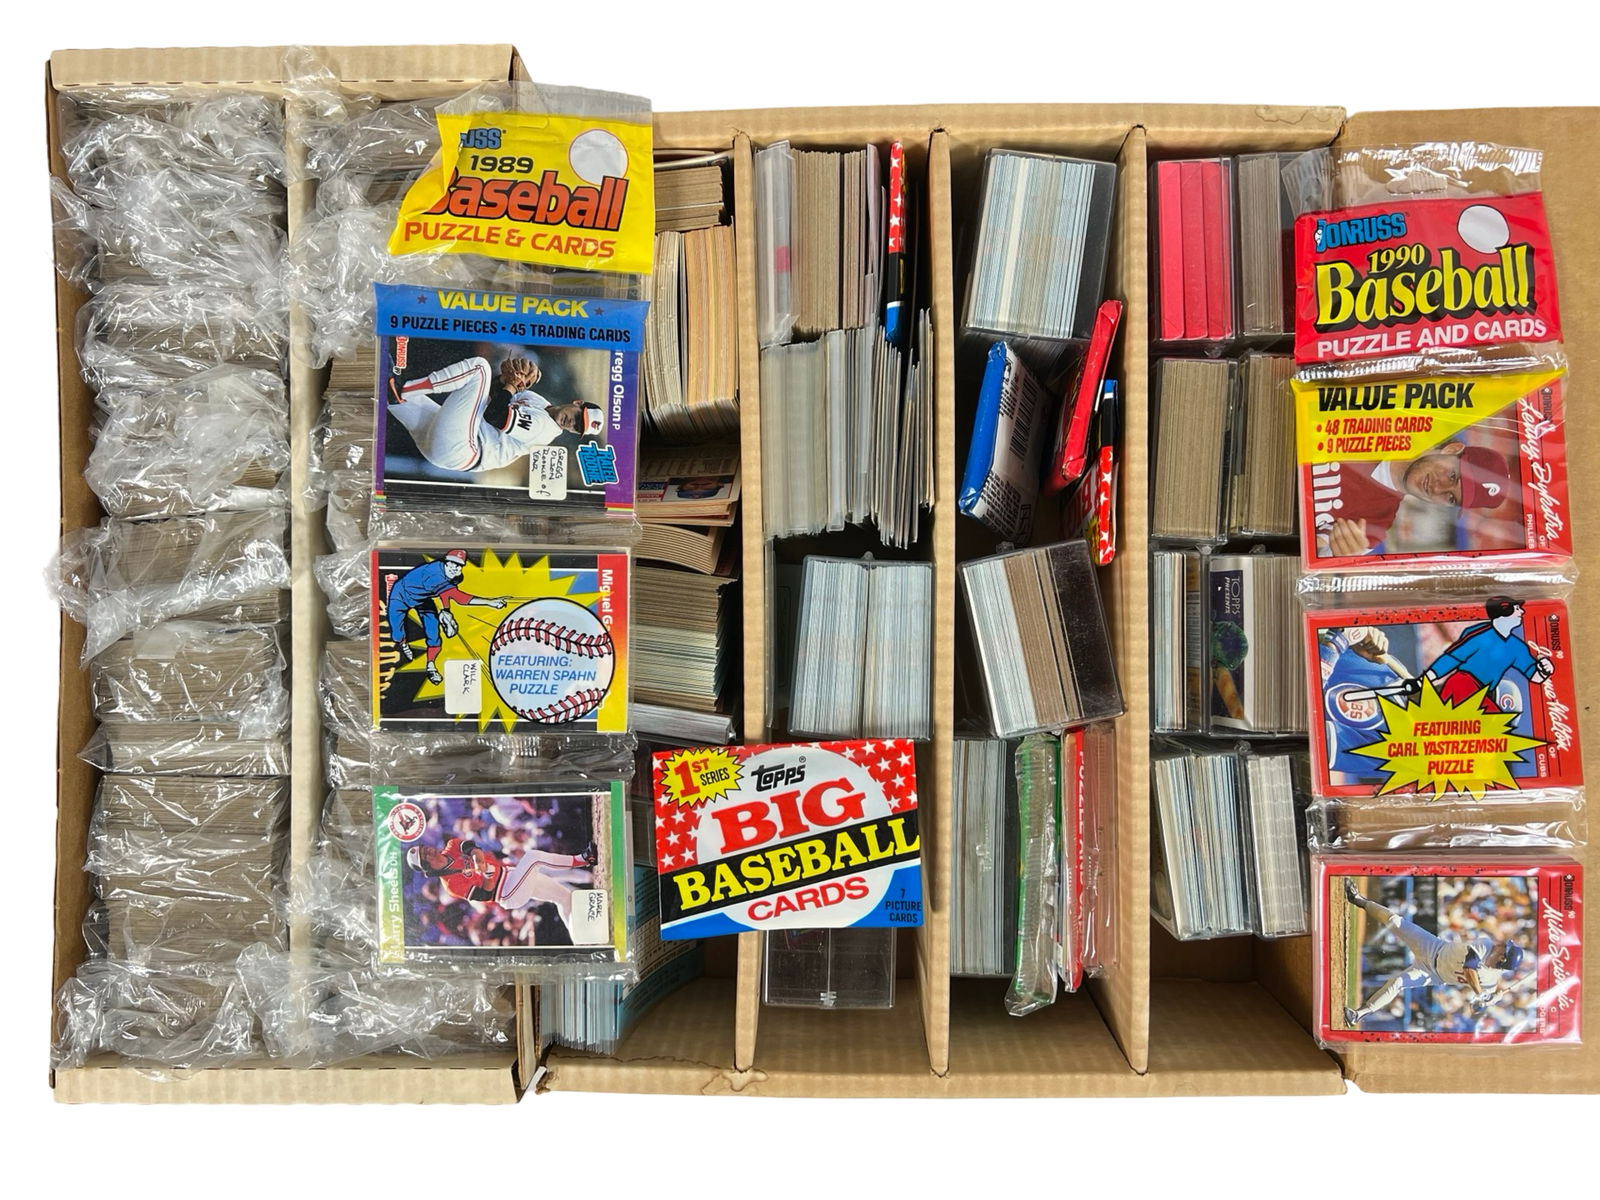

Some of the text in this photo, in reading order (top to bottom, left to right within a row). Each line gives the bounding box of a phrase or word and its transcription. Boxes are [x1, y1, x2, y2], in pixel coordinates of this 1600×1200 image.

[470, 154, 533, 174] 1989
[404, 221, 617, 258] PUZZLE & CARDS
[1369, 243, 1425, 274] 1990
[1315, 244, 1534, 330] Baseball
[437, 290, 589, 318] VALUE PACK
[390, 315, 631, 343] 9 PUZZLE PIECES 45 TRADING CARDS
[1317, 318, 1547, 358] PUZZLE AND CARDS
[612, 351, 624, 431] regg Olson P
[1318, 382, 1476, 412] VALUE PACK
[1325, 416, 1434, 436] 48 TRADING CARDS
[1327, 436, 1411, 453] 9 PUZZLE PIECES
[549, 450, 557, 480] OLSON
[556, 448, 566, 479] GREGG
[1518, 398, 1563, 542] Lenny Dykstra
[1526, 513, 1535, 549] PHILLIES
[1539, 535, 1546, 547] OF
[1231, 576, 1240, 615] TOPPS
[496, 669, 596, 682] WARREN SPAHN
[497, 655, 573, 668] FEATURING:
[462, 663, 470, 695] CLARK
[509, 683, 559, 695] PUZZLE
[1413, 719, 1481, 738] FEATURING
[1546, 699, 1573, 752] Walton
[1387, 738, 1508, 757] CARL YASTRZEMSKI
[1549, 746, 1556, 758] OF
[700, 768, 731, 787] SERIES
[1427, 759, 1474, 775] PUZZLE
[1538, 753, 1547, 778] CUBS
[710, 777, 866, 855] BIG
[673, 817, 921, 911] BASEBALL
[587, 892, 596, 922] GRACE
[747, 876, 870, 922] CARDS
[885, 901, 921, 913] PICTURE
[900, 888, 906, 900] 7
[889, 912, 919, 924] CARDS
[1542, 898, 1564, 943] Mike
